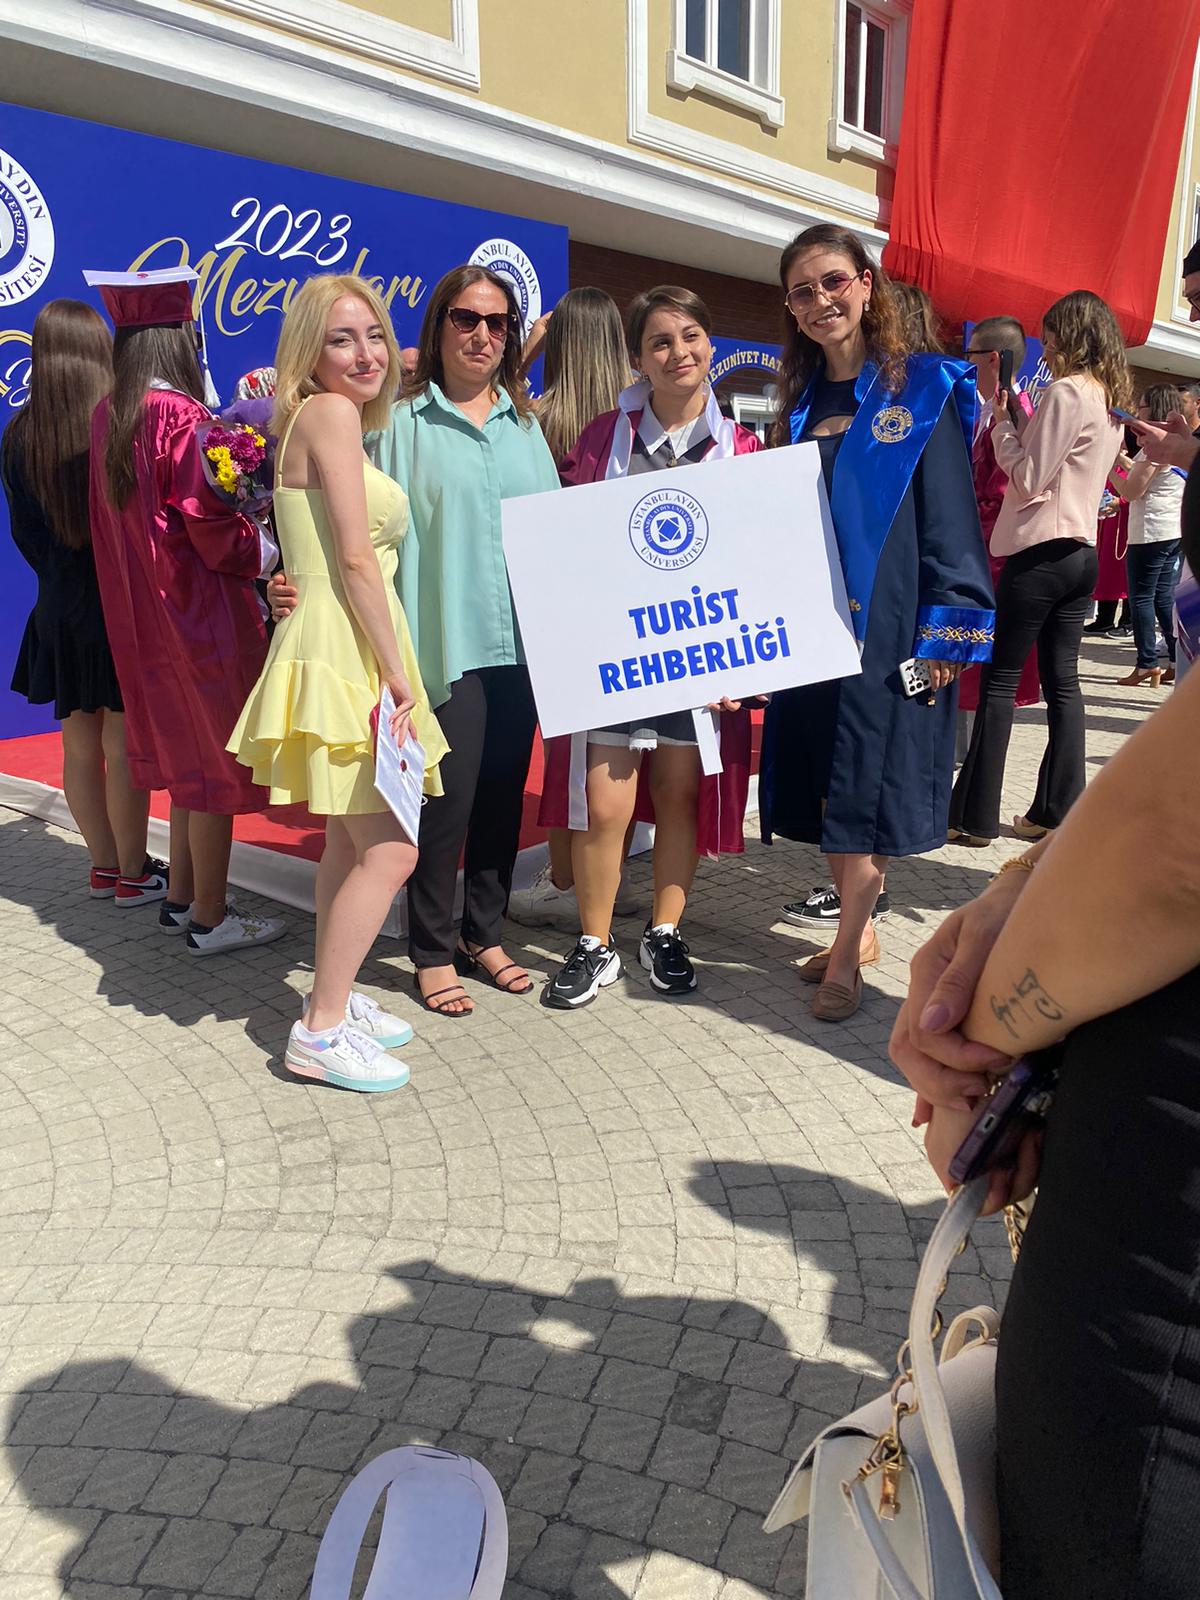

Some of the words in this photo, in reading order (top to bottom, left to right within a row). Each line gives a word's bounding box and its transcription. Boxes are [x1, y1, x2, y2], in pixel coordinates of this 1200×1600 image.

[215, 197, 352, 266] 2023
[513, 253, 539, 295] AYDIN
[631, 492, 671, 530] İSTANBUL
[673, 494, 703, 520] AYDIN
[640, 536, 705, 568] ÜNİVERSİTESİ
[628, 585, 740, 639] TURİST
[598, 616, 791, 694] REHBERLİĞİ
